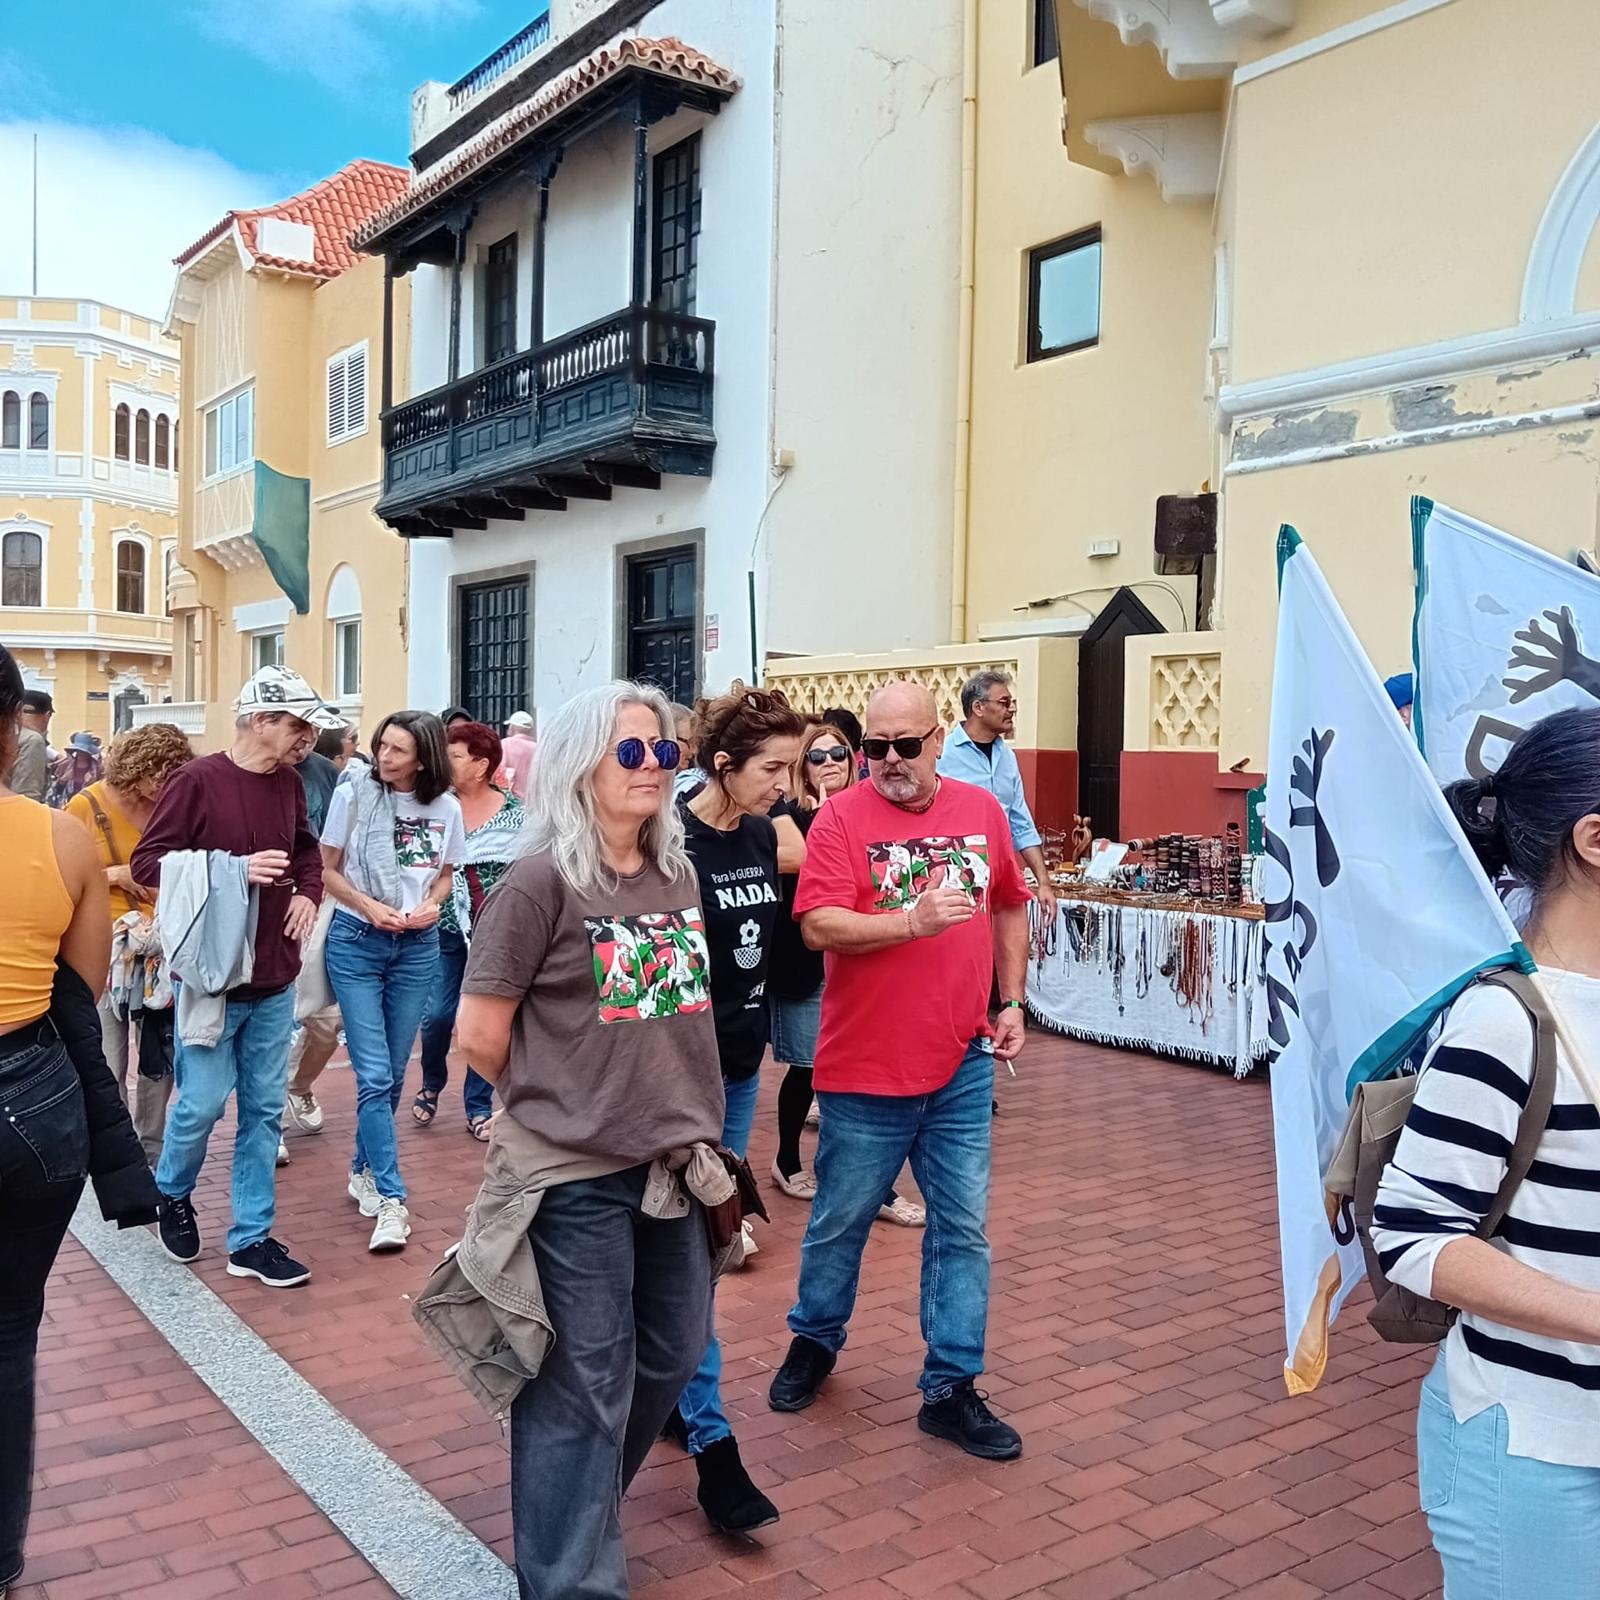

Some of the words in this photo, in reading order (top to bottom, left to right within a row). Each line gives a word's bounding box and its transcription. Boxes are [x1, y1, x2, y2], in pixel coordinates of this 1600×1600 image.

[711, 873, 730, 884] Para
[728, 870, 737, 881] la
[736, 866, 765, 880] GUERRA
[714, 881, 778, 910] NADA
